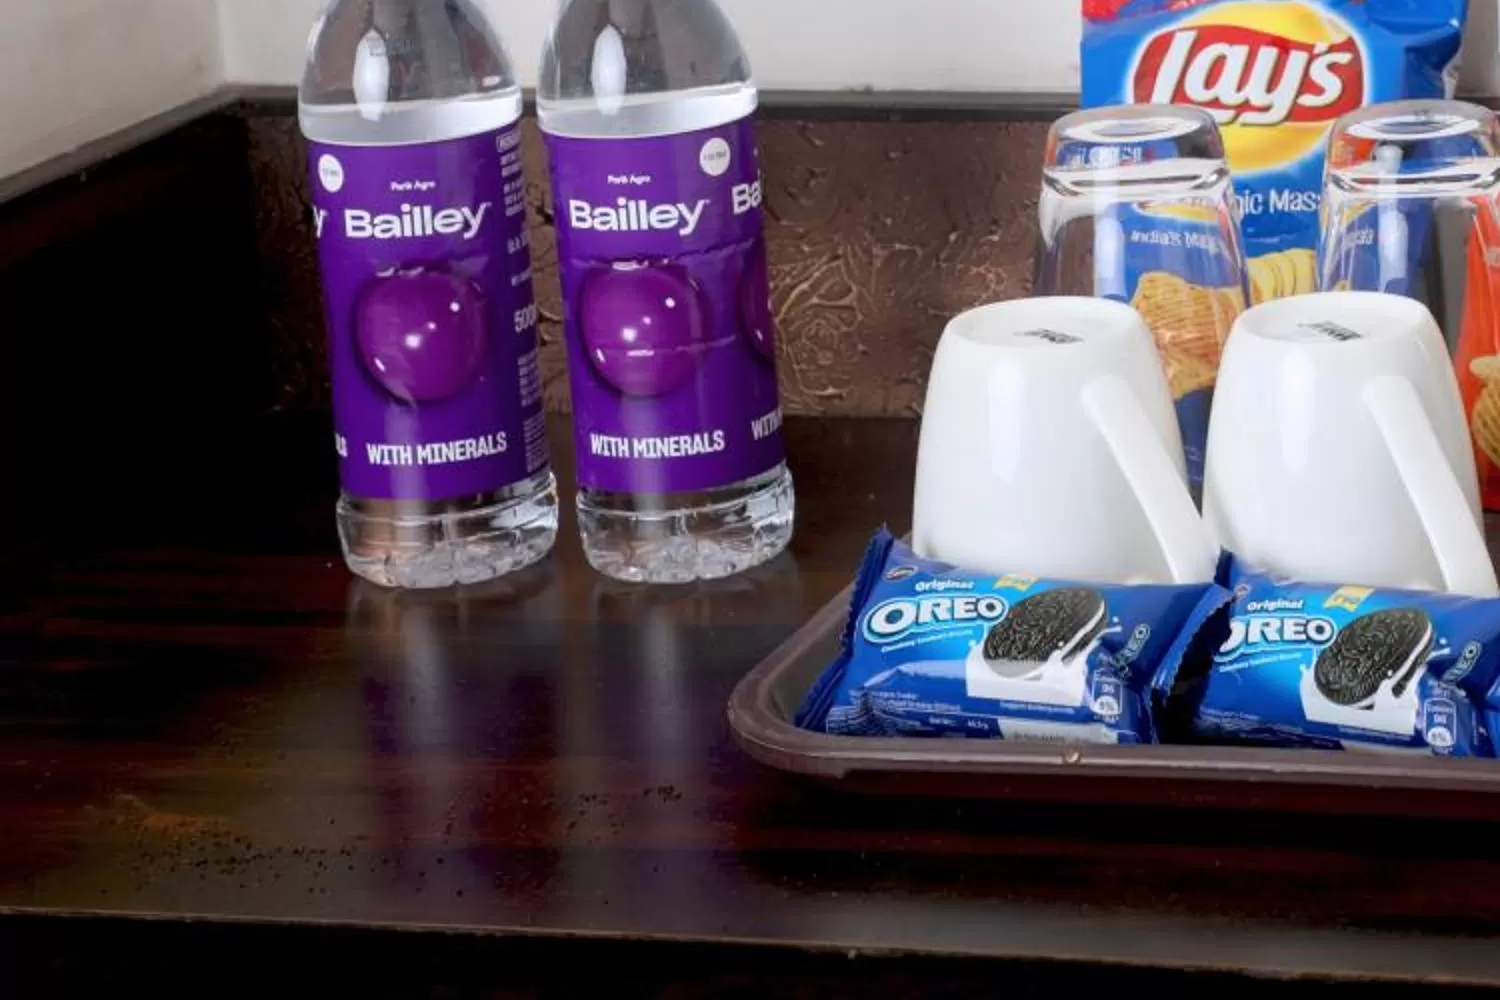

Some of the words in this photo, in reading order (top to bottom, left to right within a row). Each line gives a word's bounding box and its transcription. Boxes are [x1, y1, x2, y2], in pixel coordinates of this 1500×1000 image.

[569, 197, 706, 237] Bailley
[1269, 188, 1321, 214] Mas
[344, 203, 488, 240] Bailley
[366, 443, 412, 465] WITH
[417, 431, 507, 465] MINERALS
[590, 432, 630, 458] WITH
[633, 429, 725, 458] MINERALS
[870, 596, 1003, 635] OREO
[1247, 599, 1304, 612] Original
